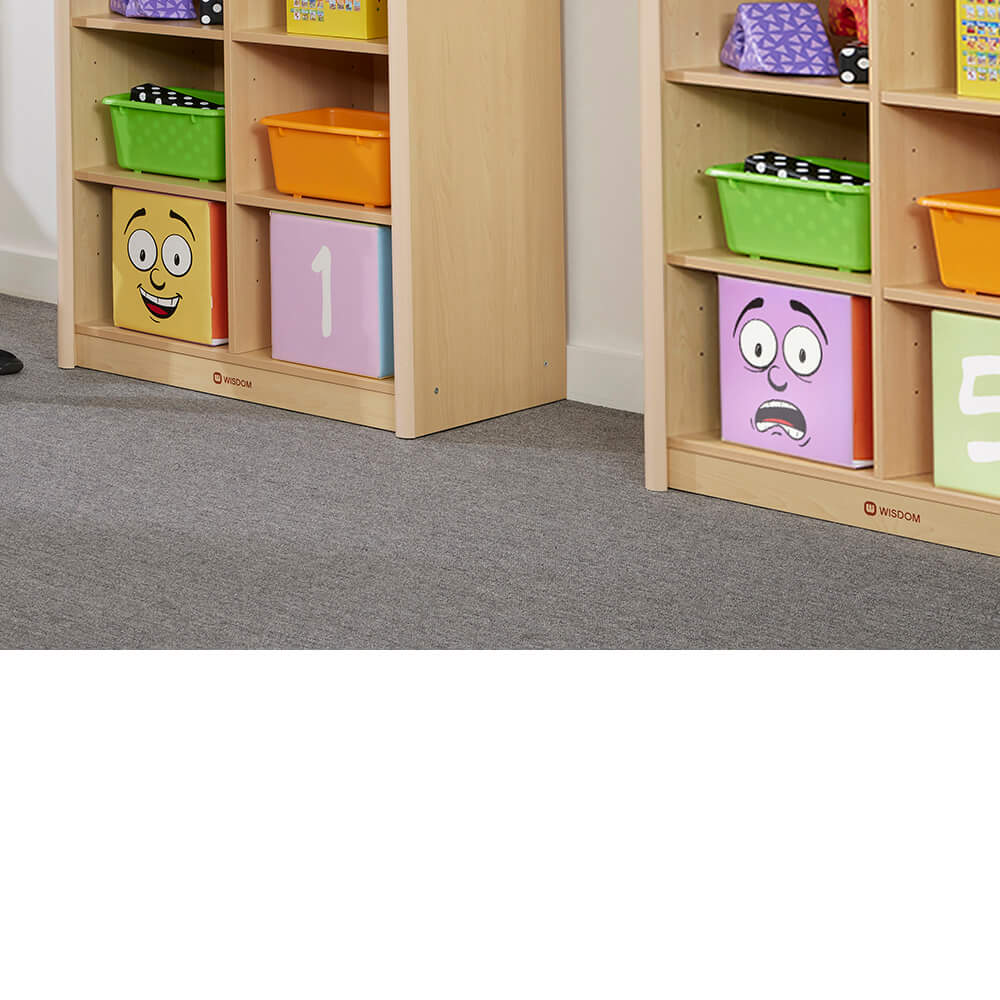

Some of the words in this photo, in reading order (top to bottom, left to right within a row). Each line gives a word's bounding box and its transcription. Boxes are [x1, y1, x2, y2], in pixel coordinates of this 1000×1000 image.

[311, 245, 332, 338] 1
[223, 375, 253, 389] WISDOM
[879, 506, 921, 524] WISDOM
